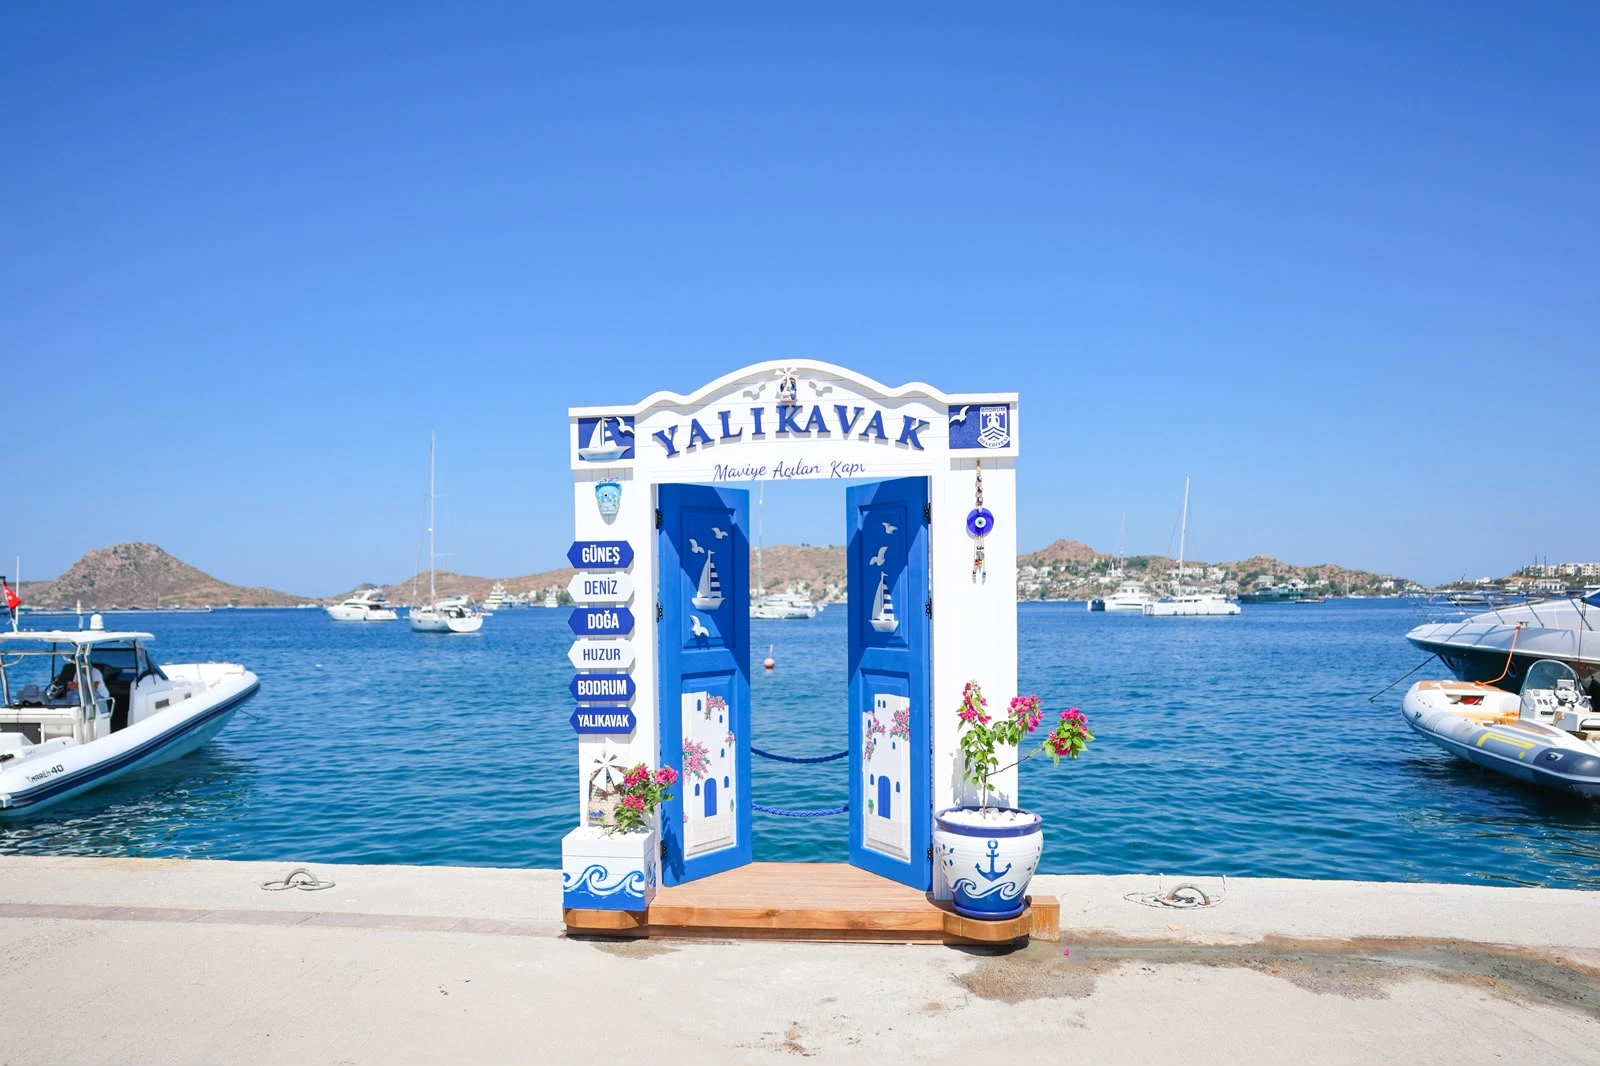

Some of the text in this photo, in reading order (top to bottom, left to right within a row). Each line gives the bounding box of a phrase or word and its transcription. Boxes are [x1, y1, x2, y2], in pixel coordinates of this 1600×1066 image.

[652, 404, 930, 458] YALIKAVAK
[713, 458, 866, 481] Maviye Açılan Kapı
[582, 544, 620, 565] GÜNEŞ
[584, 577, 618, 595] DENİZ
[587, 610, 620, 629] DOĞA
[583, 648, 621, 661] HUZUR
[577, 679, 627, 696] BODRUM
[577, 714, 629, 727] YALIKAVAK
[51, 764, 64, 774] 40
